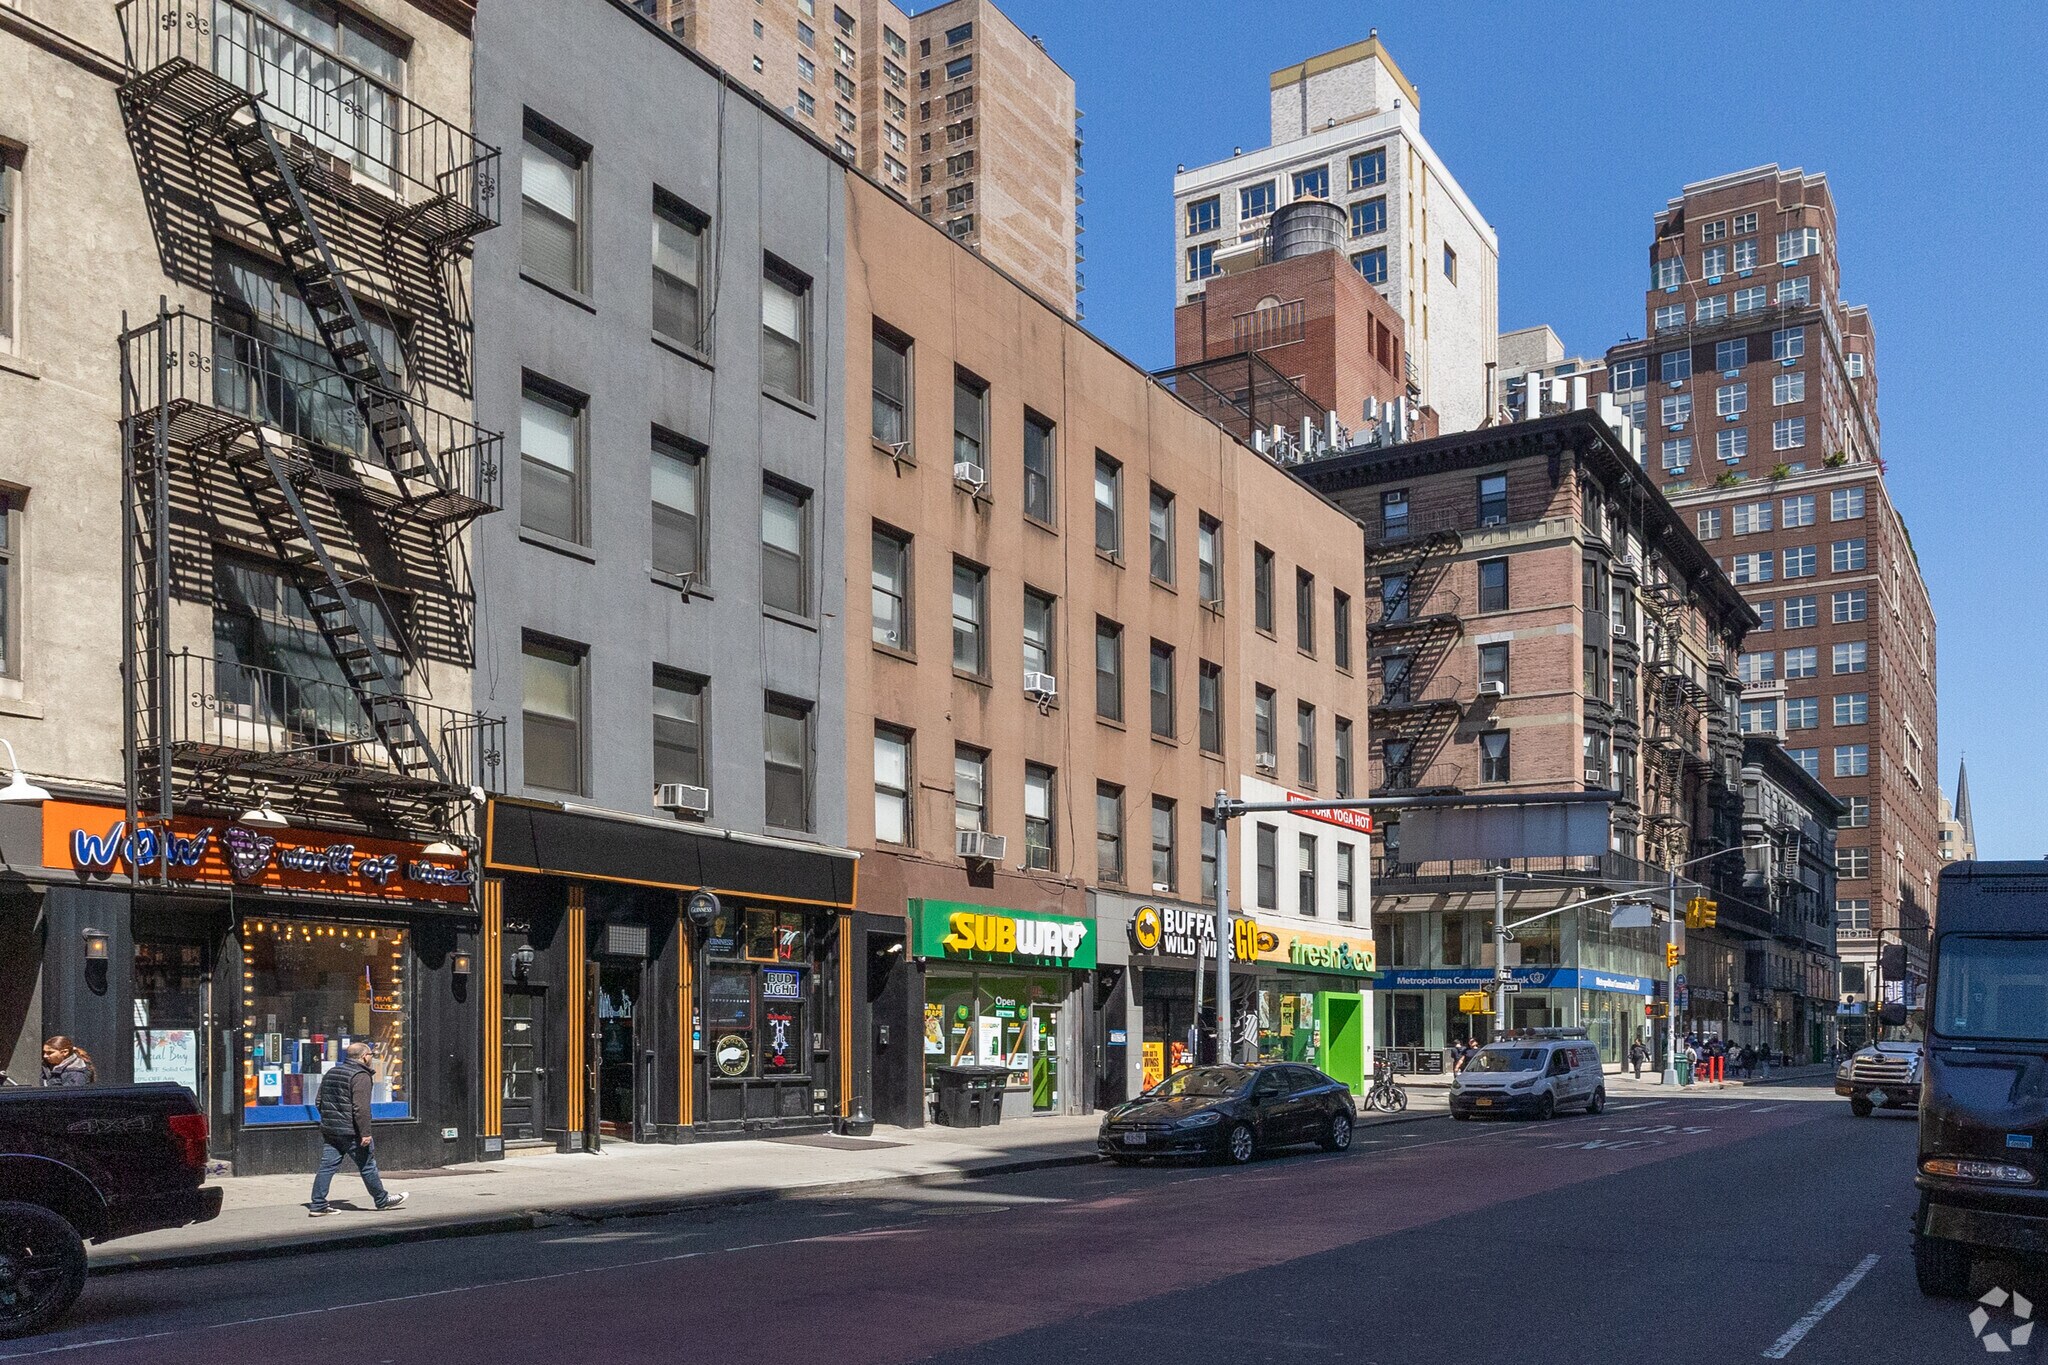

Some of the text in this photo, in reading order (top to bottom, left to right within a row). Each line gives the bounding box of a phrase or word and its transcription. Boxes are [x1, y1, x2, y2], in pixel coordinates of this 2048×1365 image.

[1333, 809, 1354, 824] YOGA
[1355, 815, 1369, 829] HOT
[943, 912, 1088, 957] SUBWAY
[1234, 918, 1258, 961] GO
[1164, 935, 1196, 955] WILD
[1290, 936, 1374, 972] fresh&co
[767, 972, 792, 984] BUD
[1397, 976, 1451, 986] Metropolitan
[995, 996, 1016, 1007] Open
